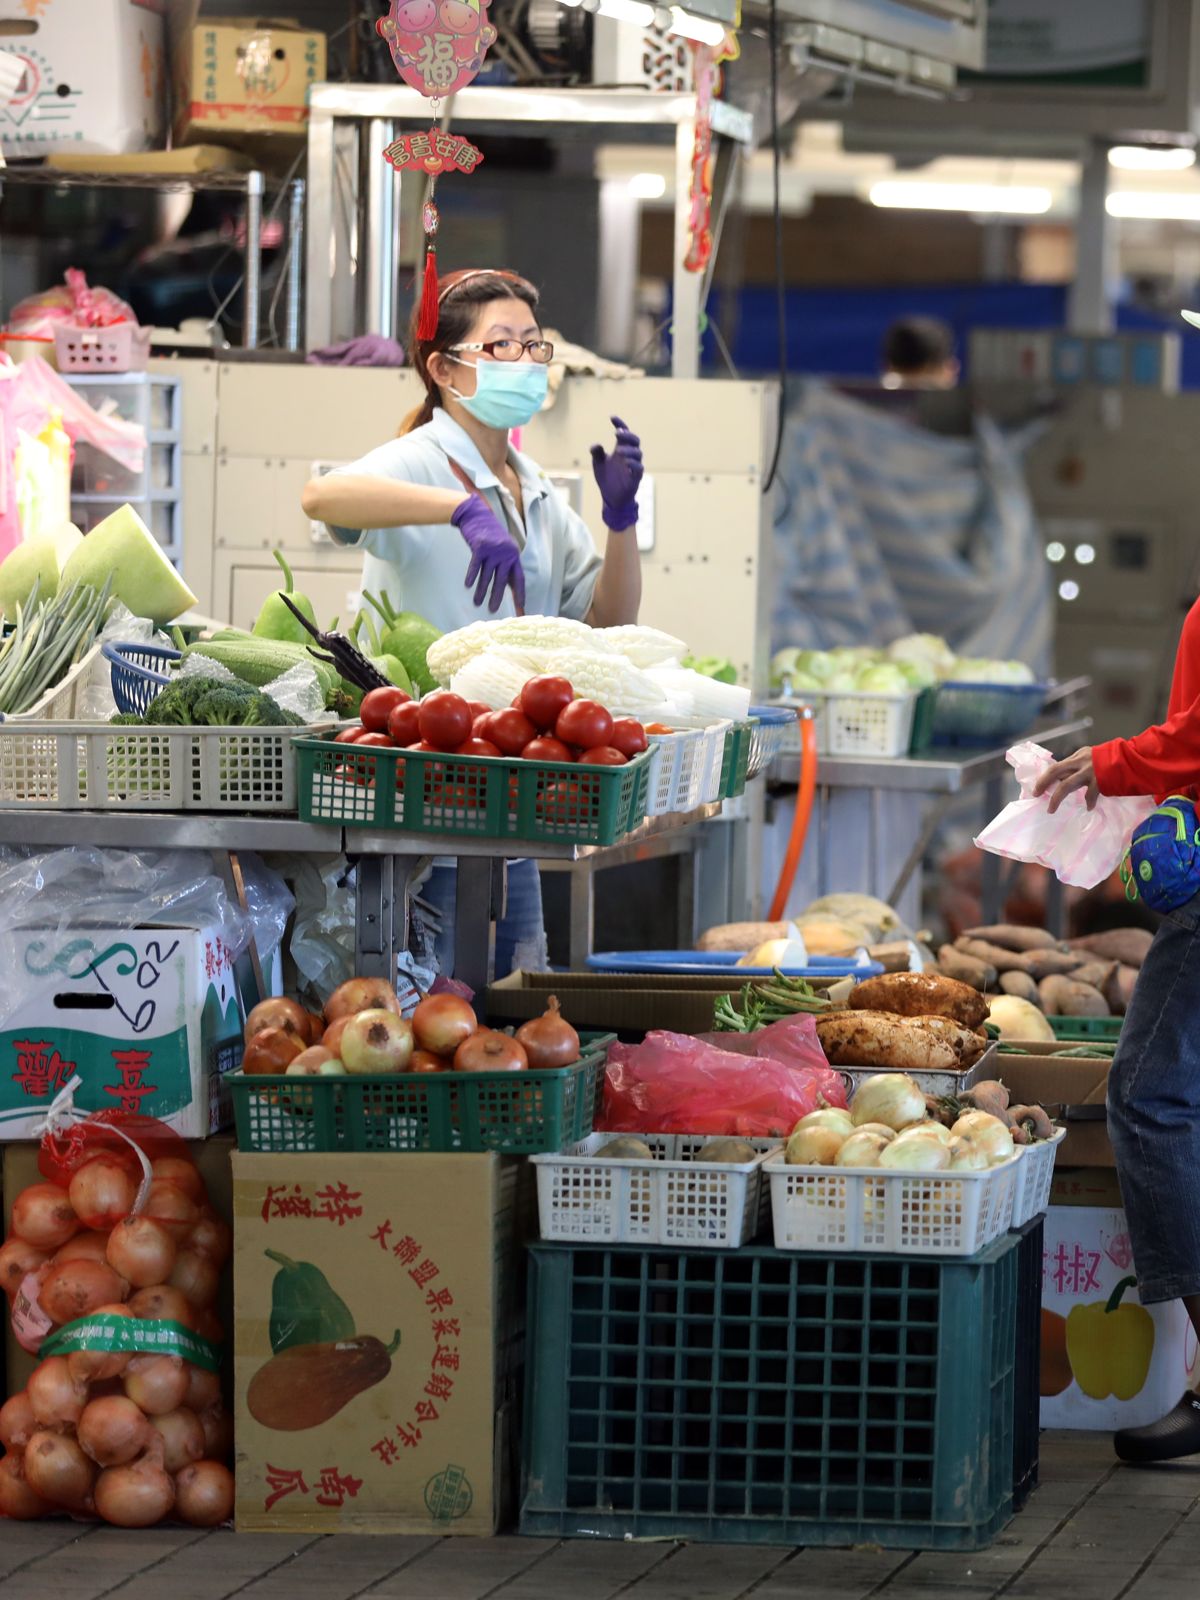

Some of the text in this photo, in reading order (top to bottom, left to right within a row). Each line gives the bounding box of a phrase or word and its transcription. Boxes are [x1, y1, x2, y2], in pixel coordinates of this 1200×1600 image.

[416, 32, 459, 85] 福
[385, 135, 481, 170] 富貴安康
[12, 1039, 158, 1113] 歡喜
[261, 1181, 363, 1226] 特選
[1042, 1242, 1102, 1294] 椒
[368, 1219, 462, 1465] 大聯盟果菜運銷合作社
[264, 1462, 364, 1512] 南瓜
